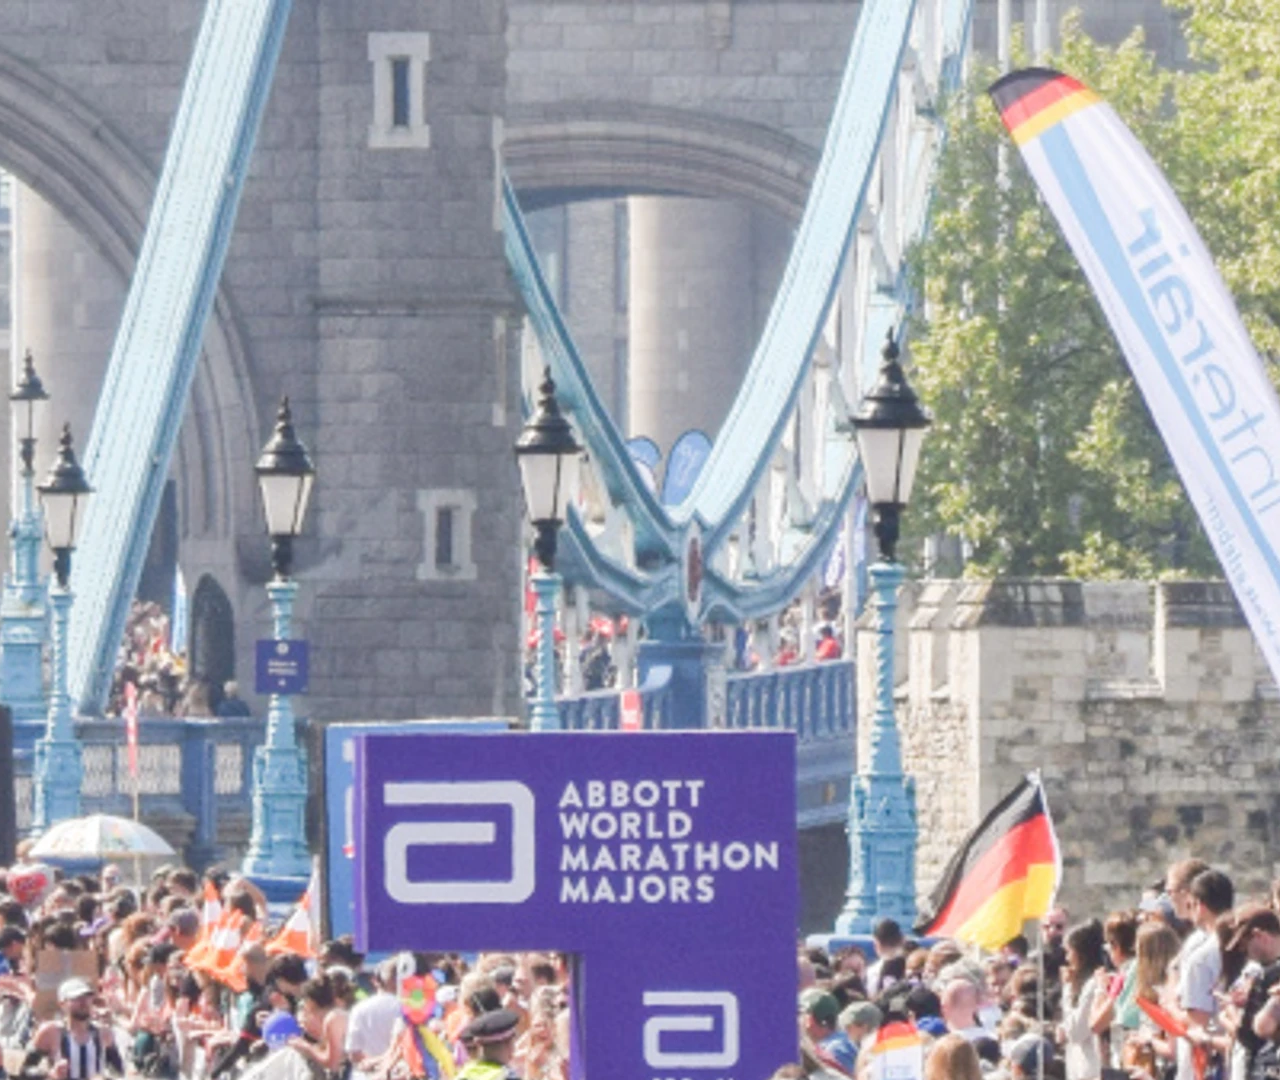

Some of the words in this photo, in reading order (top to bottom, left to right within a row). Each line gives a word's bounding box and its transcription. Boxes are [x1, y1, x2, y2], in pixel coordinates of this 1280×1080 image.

[559, 780, 705, 808] ABBOTT
[559, 811, 693, 840] WORLD
[559, 842, 780, 872] MARATHON
[559, 875, 716, 903] MAJORS
